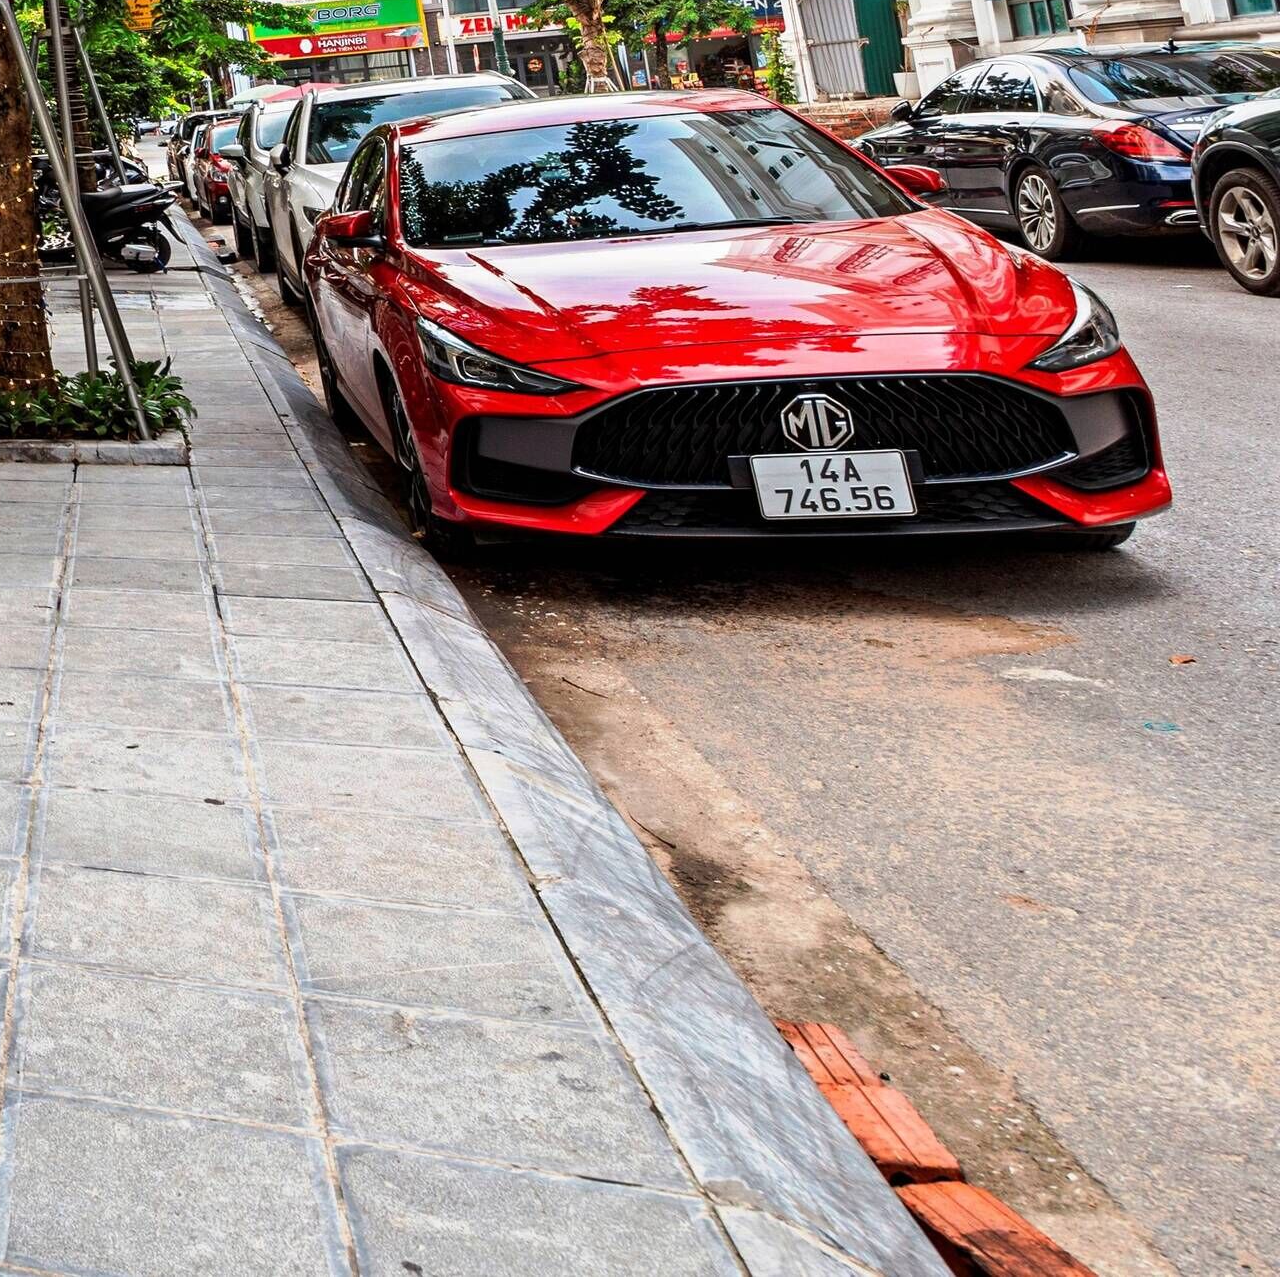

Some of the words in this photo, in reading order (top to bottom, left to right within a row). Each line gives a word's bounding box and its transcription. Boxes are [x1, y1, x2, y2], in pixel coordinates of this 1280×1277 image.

[317, 37, 367, 48] HANJINBI
[787, 399, 848, 447] MG
[800, 457, 862, 483] 14A
[775, 486, 895, 514] 746.56
